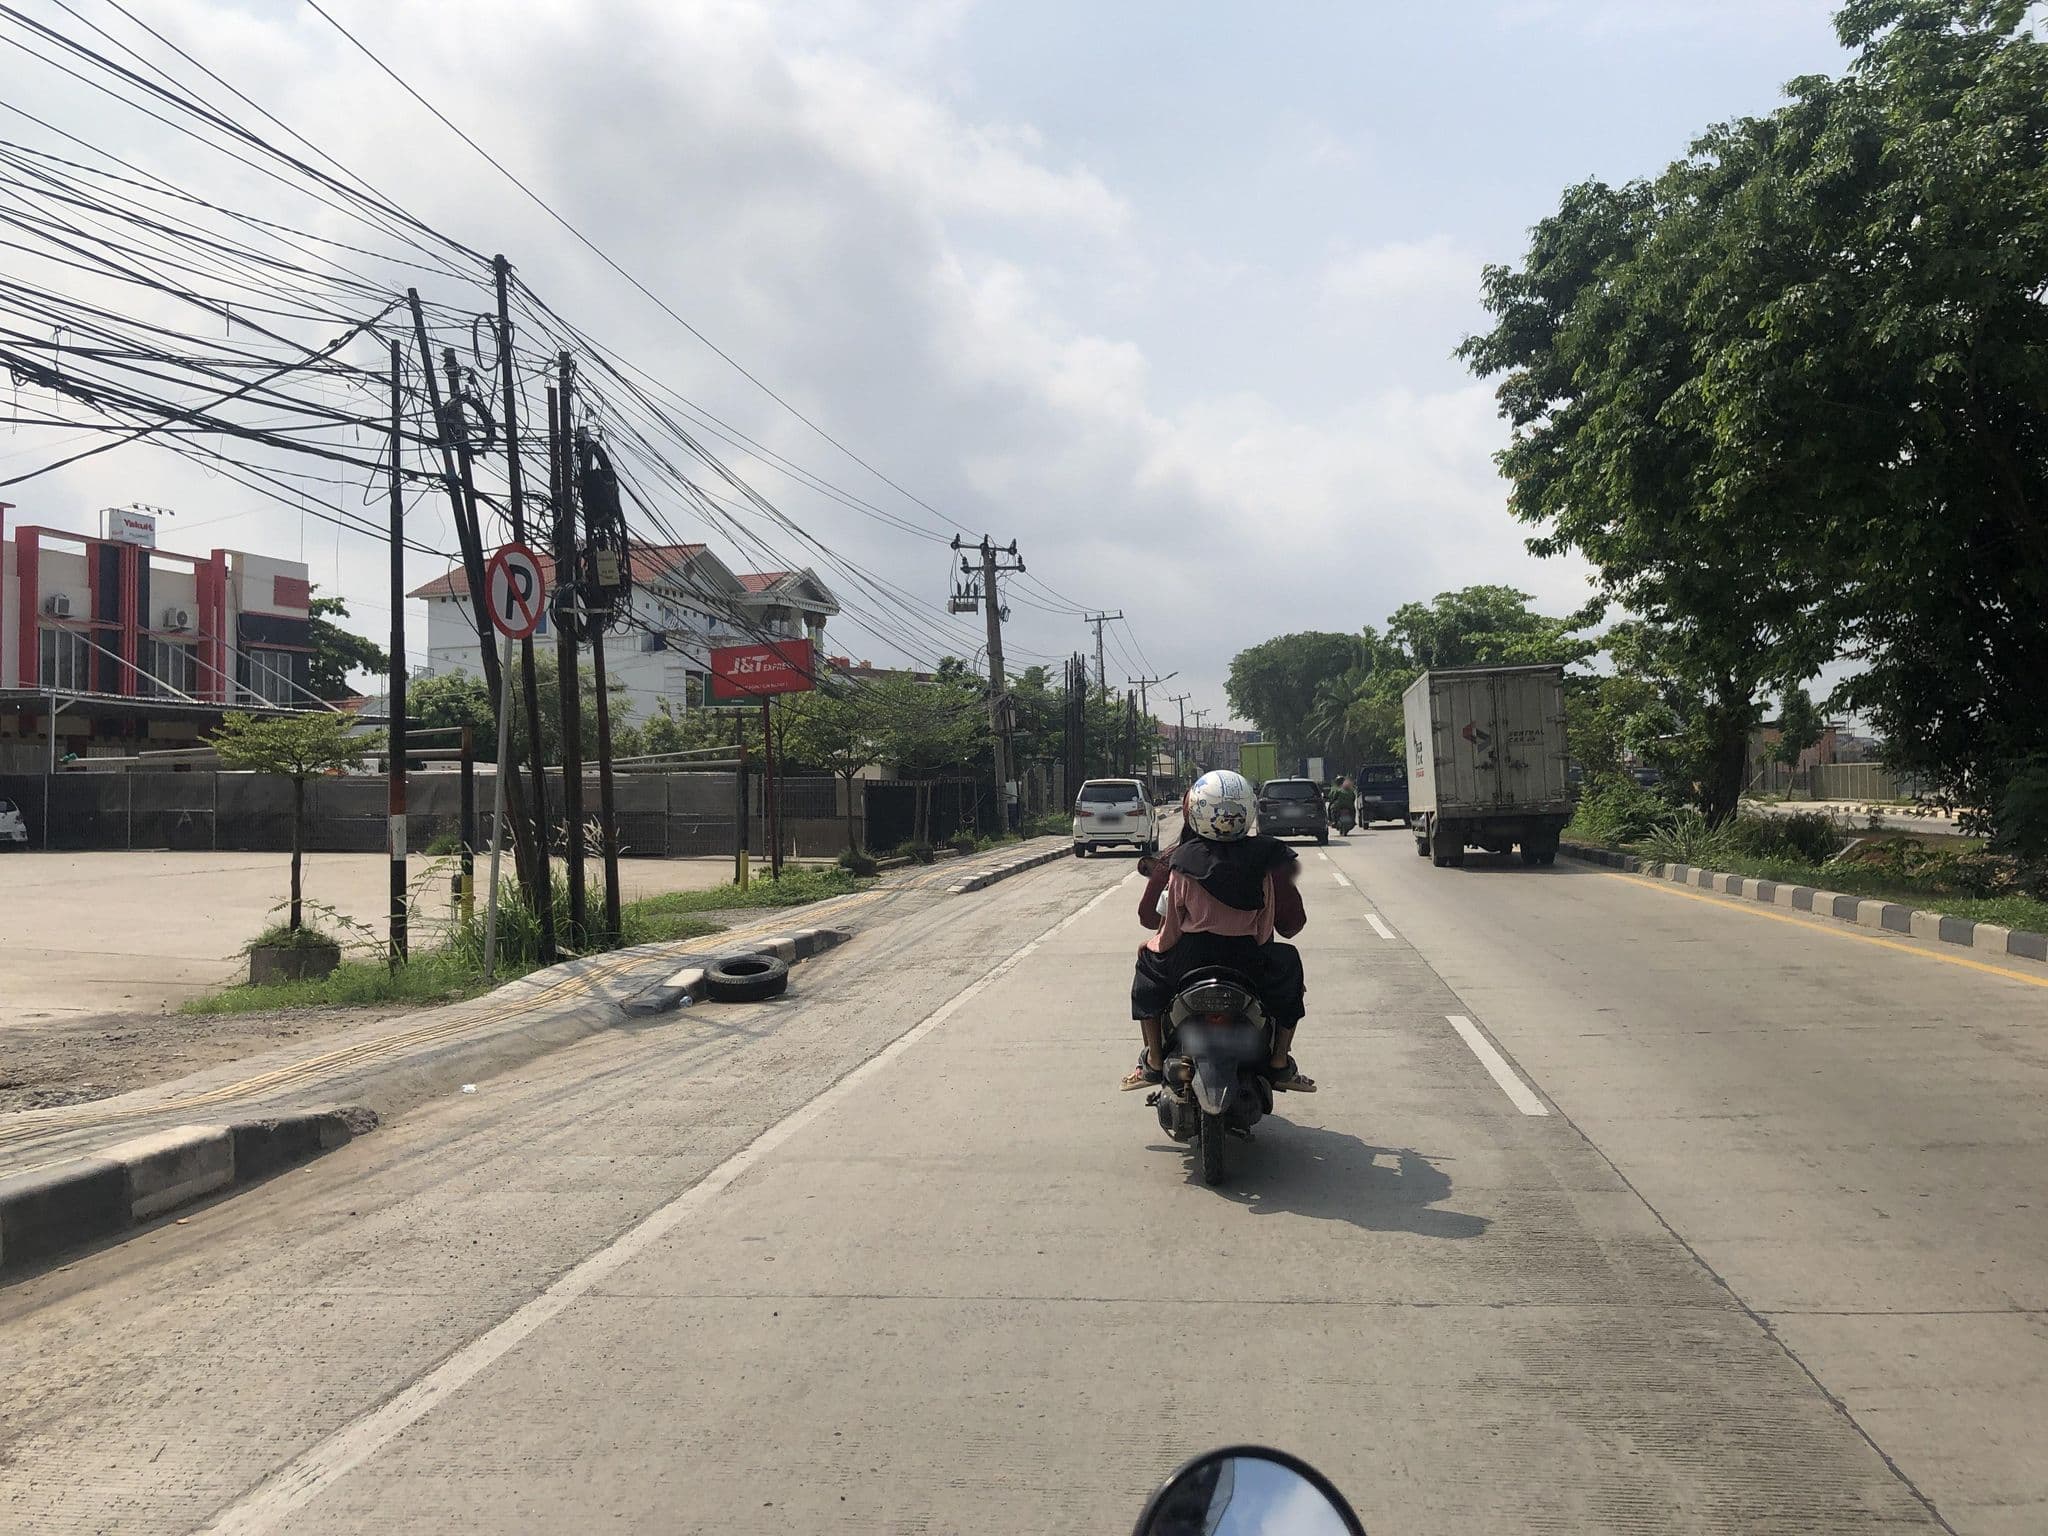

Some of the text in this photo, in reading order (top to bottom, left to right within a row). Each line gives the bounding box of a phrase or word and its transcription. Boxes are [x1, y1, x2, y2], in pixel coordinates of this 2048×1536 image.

[123, 518, 154, 532] Yakult
[505, 564, 532, 620] P
[727, 654, 794, 675] J&T EXPRE
